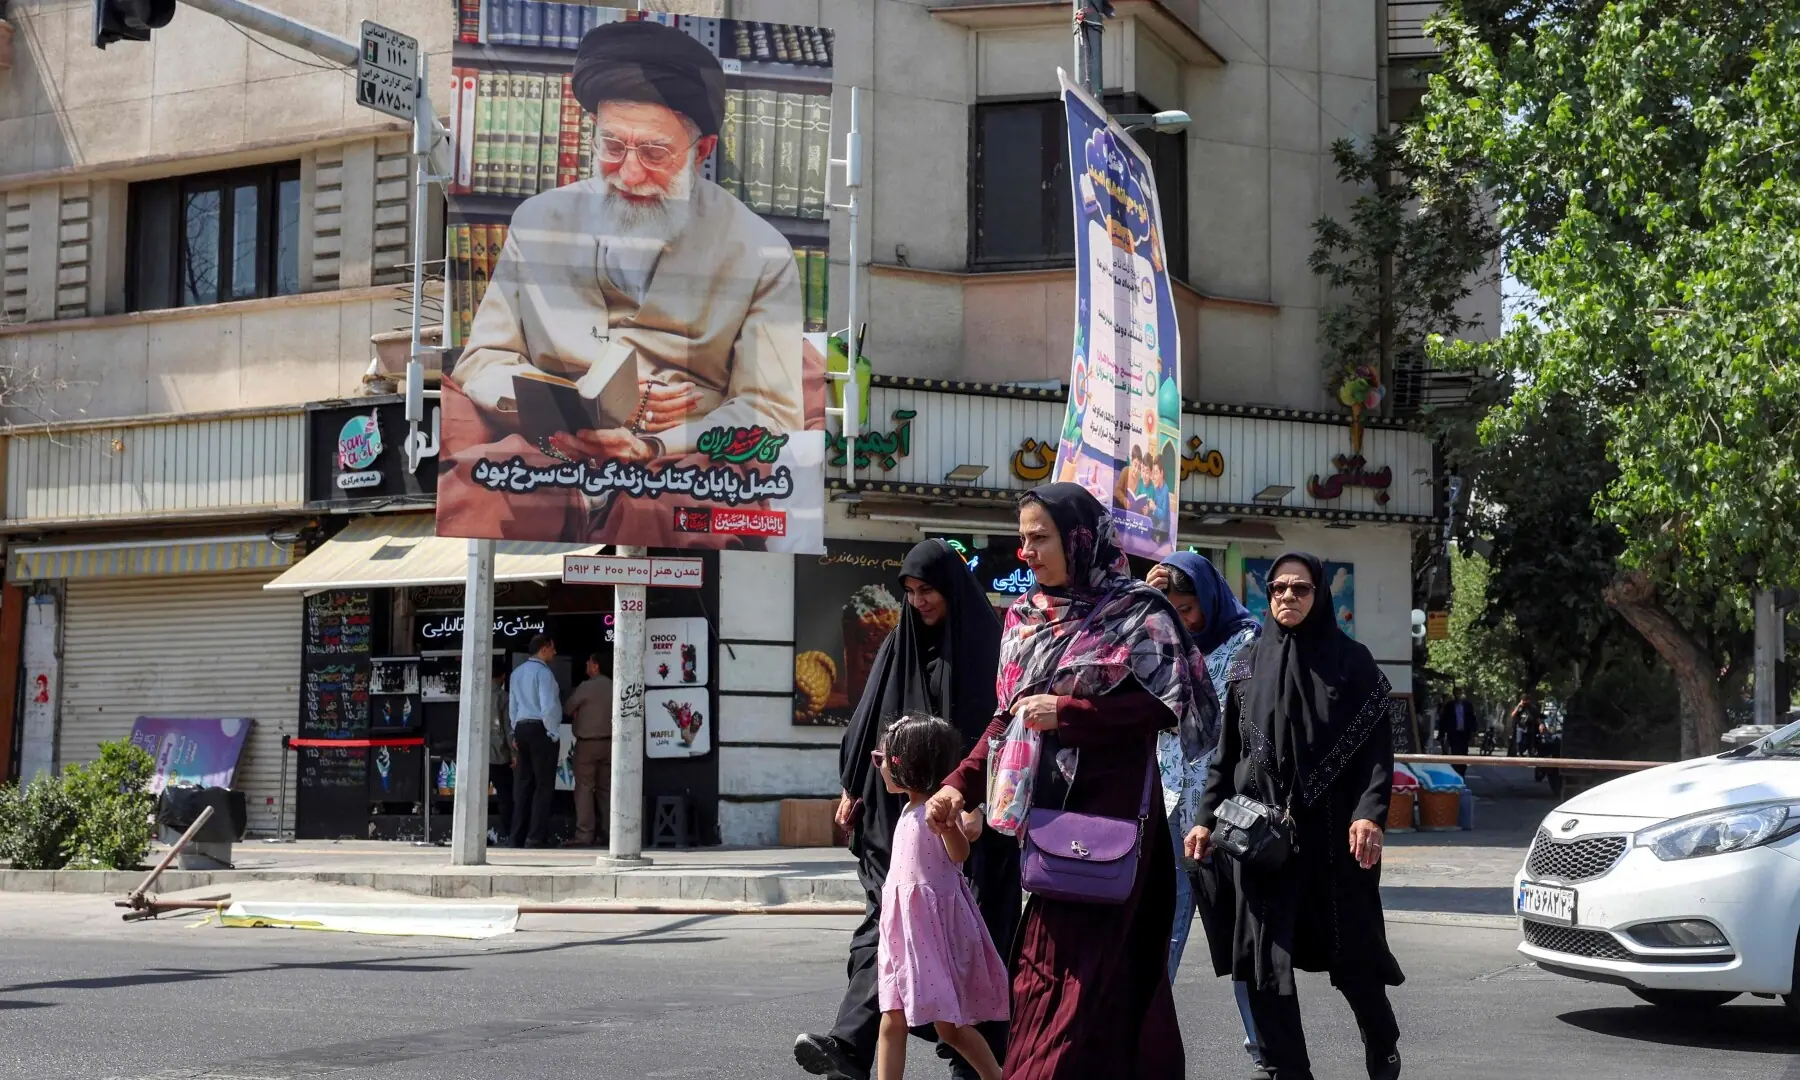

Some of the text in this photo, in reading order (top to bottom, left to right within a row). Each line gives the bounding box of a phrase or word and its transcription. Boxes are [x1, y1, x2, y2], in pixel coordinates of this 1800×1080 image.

[391, 36, 405, 49] چراغ
[387, 48, 407, 66] ۱۱۱۰
[362, 69, 380, 80] خرابی
[381, 75, 401, 89] گزارش
[378, 89, 411, 111] ۸۷۵۰۰
[339, 434, 364, 454] San
[341, 473, 377, 486] شعبه مرکزی
[475, 461, 508, 488] بود
[511, 461, 557, 492] سرخ
[648, 465, 696, 496] کتاب
[738, 469, 790, 499] فصل
[693, 470, 739, 502] پایان
[567, 563, 700, 579] تمدن هنر ۰۹۱۲ ۴ ۲۰۰ ۳۰۰
[620, 600, 644, 612] 328
[422, 614, 465, 638] تالیایی
[503, 614, 545, 637] بستنی
[650, 634, 677, 642] CHOCO
[650, 730, 675, 739] WAFFLE
